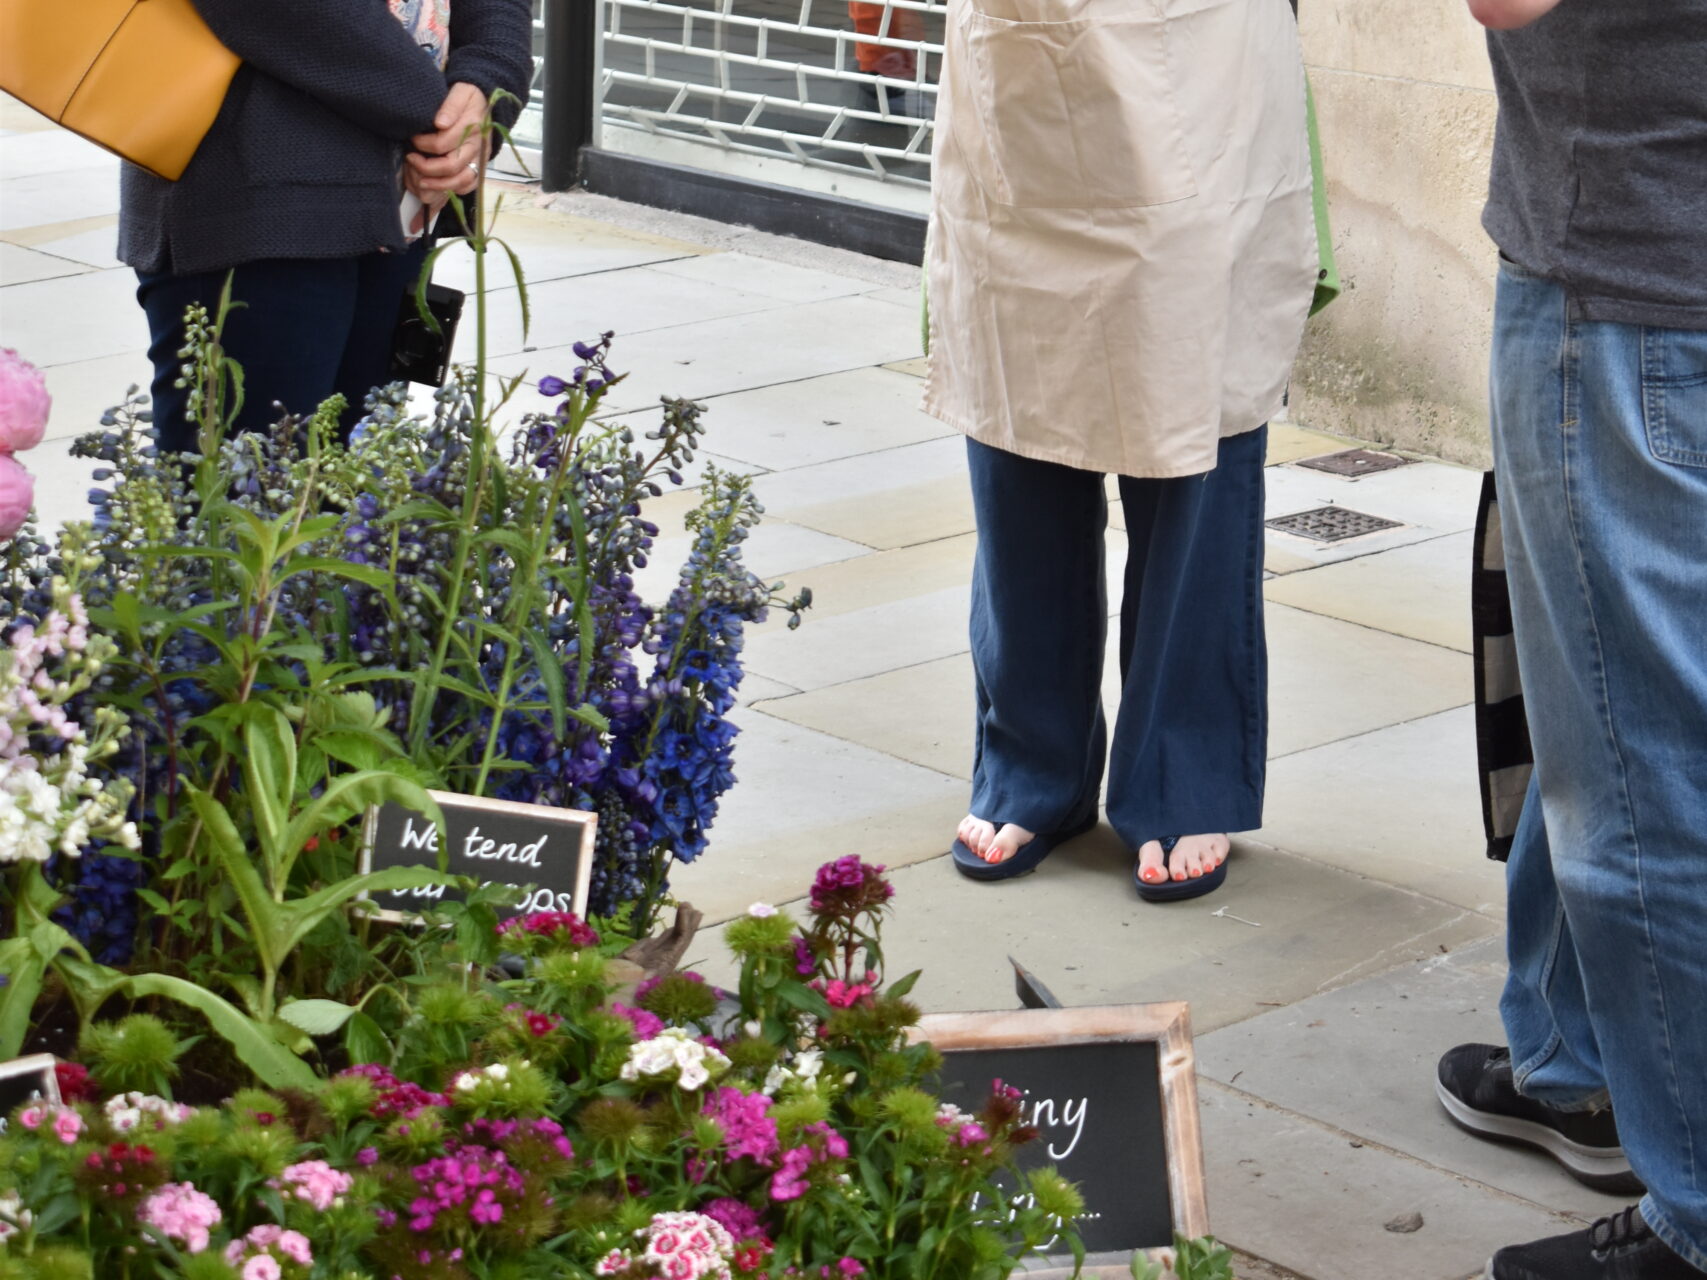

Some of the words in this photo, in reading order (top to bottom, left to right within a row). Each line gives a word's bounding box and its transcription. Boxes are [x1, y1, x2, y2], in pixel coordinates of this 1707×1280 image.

[400, 817, 440, 852] We
[463, 826, 548, 868] tend
[1003, 1083, 1088, 1160] iny
